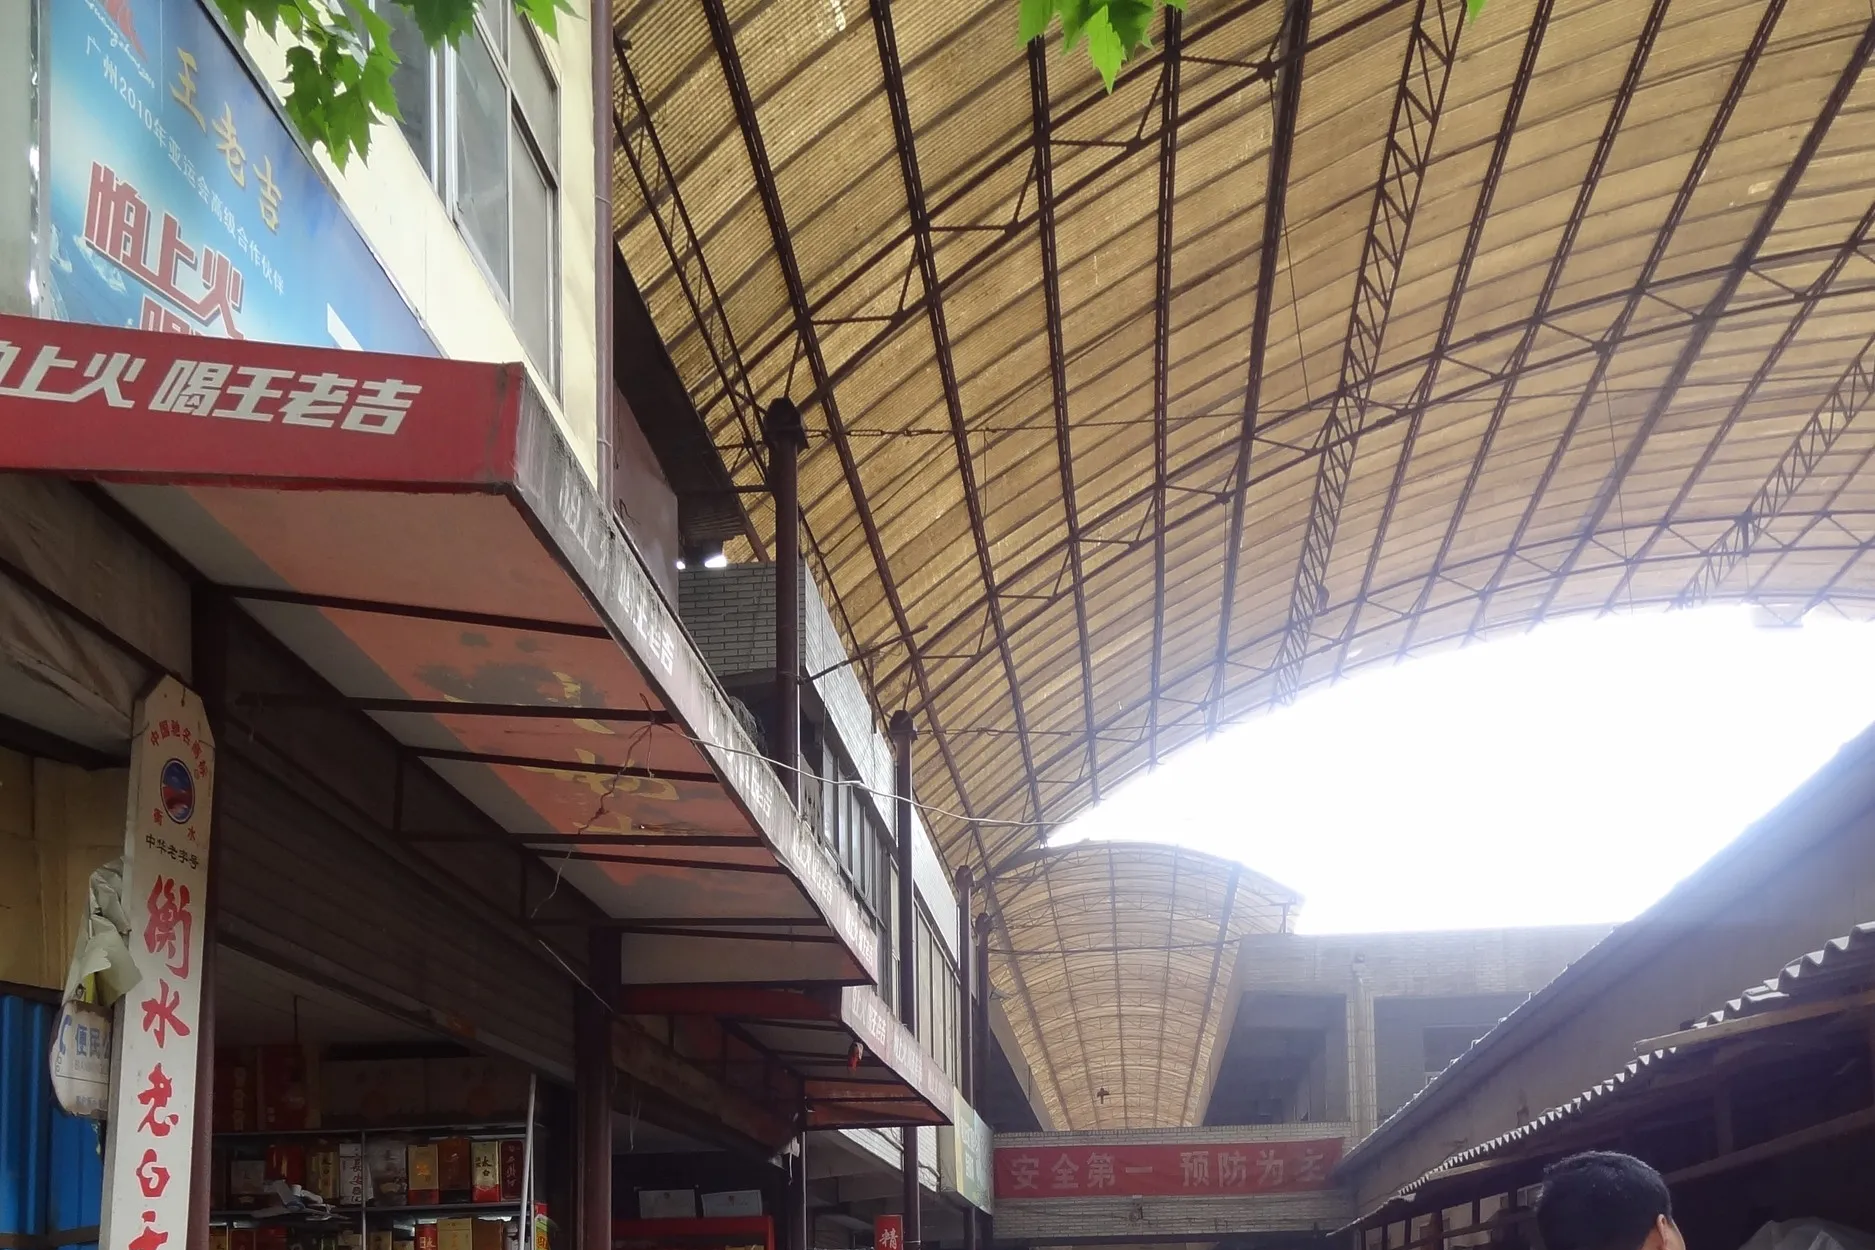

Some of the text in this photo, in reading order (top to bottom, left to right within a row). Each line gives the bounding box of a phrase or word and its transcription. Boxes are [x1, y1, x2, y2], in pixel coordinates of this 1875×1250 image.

[168, 46, 282, 235] 王老吉
[83, 160, 245, 340] 怕上火
[149, 359, 423, 435] 喝王老吉
[145, 833, 200, 870] 中华老字号
[1010, 1151, 1153, 1190] 安全第一
